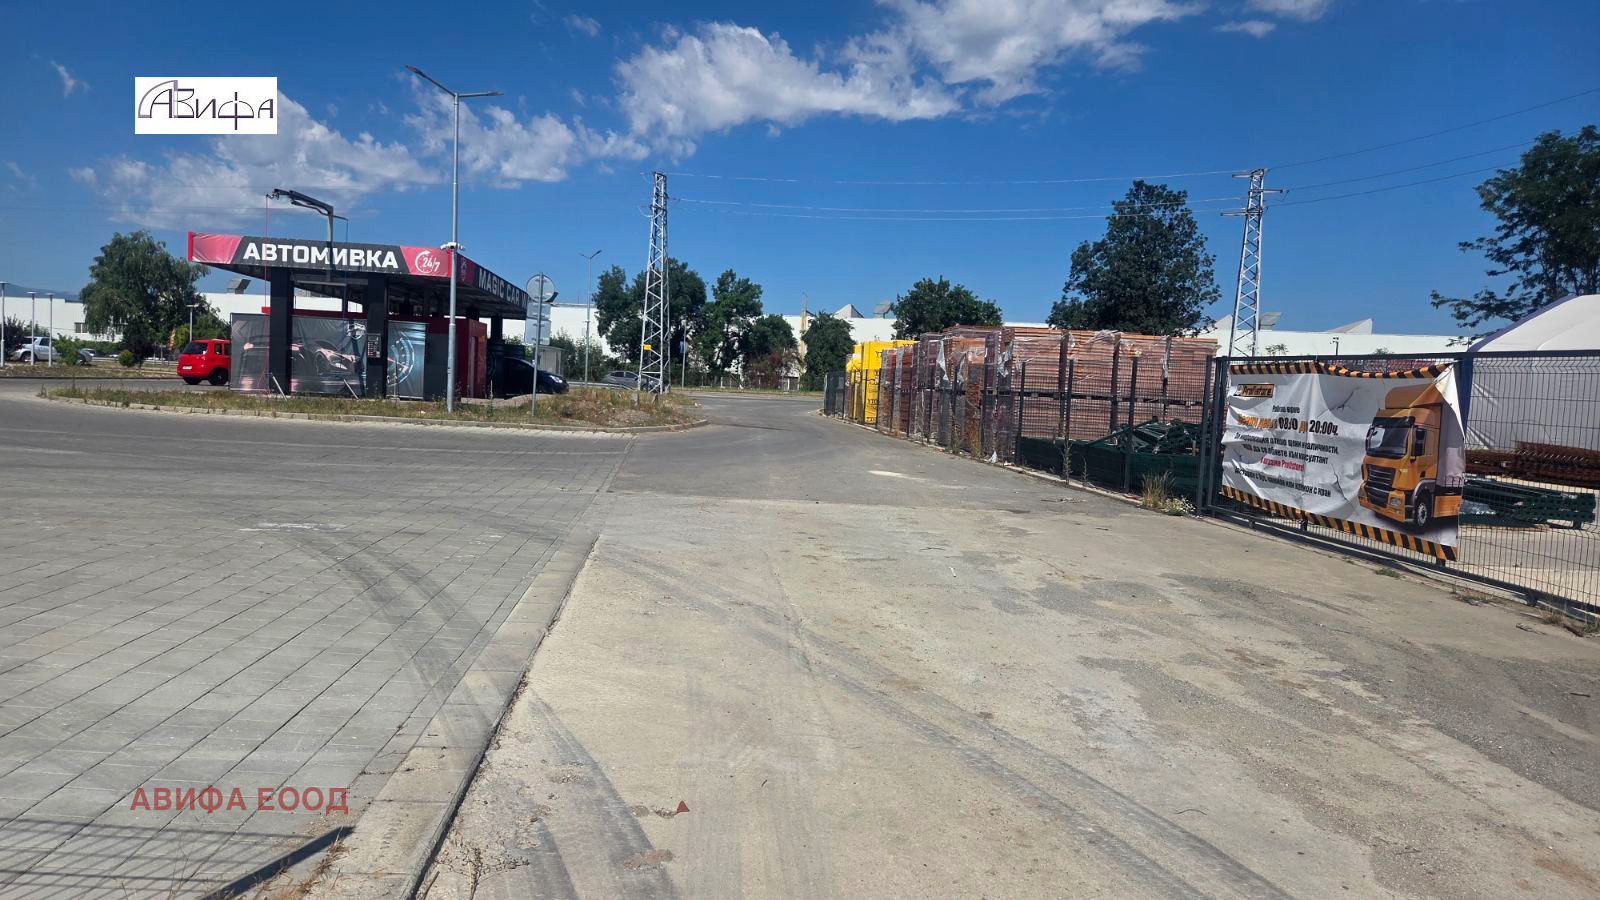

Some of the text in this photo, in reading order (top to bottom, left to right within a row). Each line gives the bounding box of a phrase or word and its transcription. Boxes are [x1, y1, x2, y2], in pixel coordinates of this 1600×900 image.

[243, 242, 399, 269] АВТОМИВКА
[422, 256, 440, 272] 24/7
[479, 268, 505, 298] MAGIC
[506, 284, 519, 306] CAR
